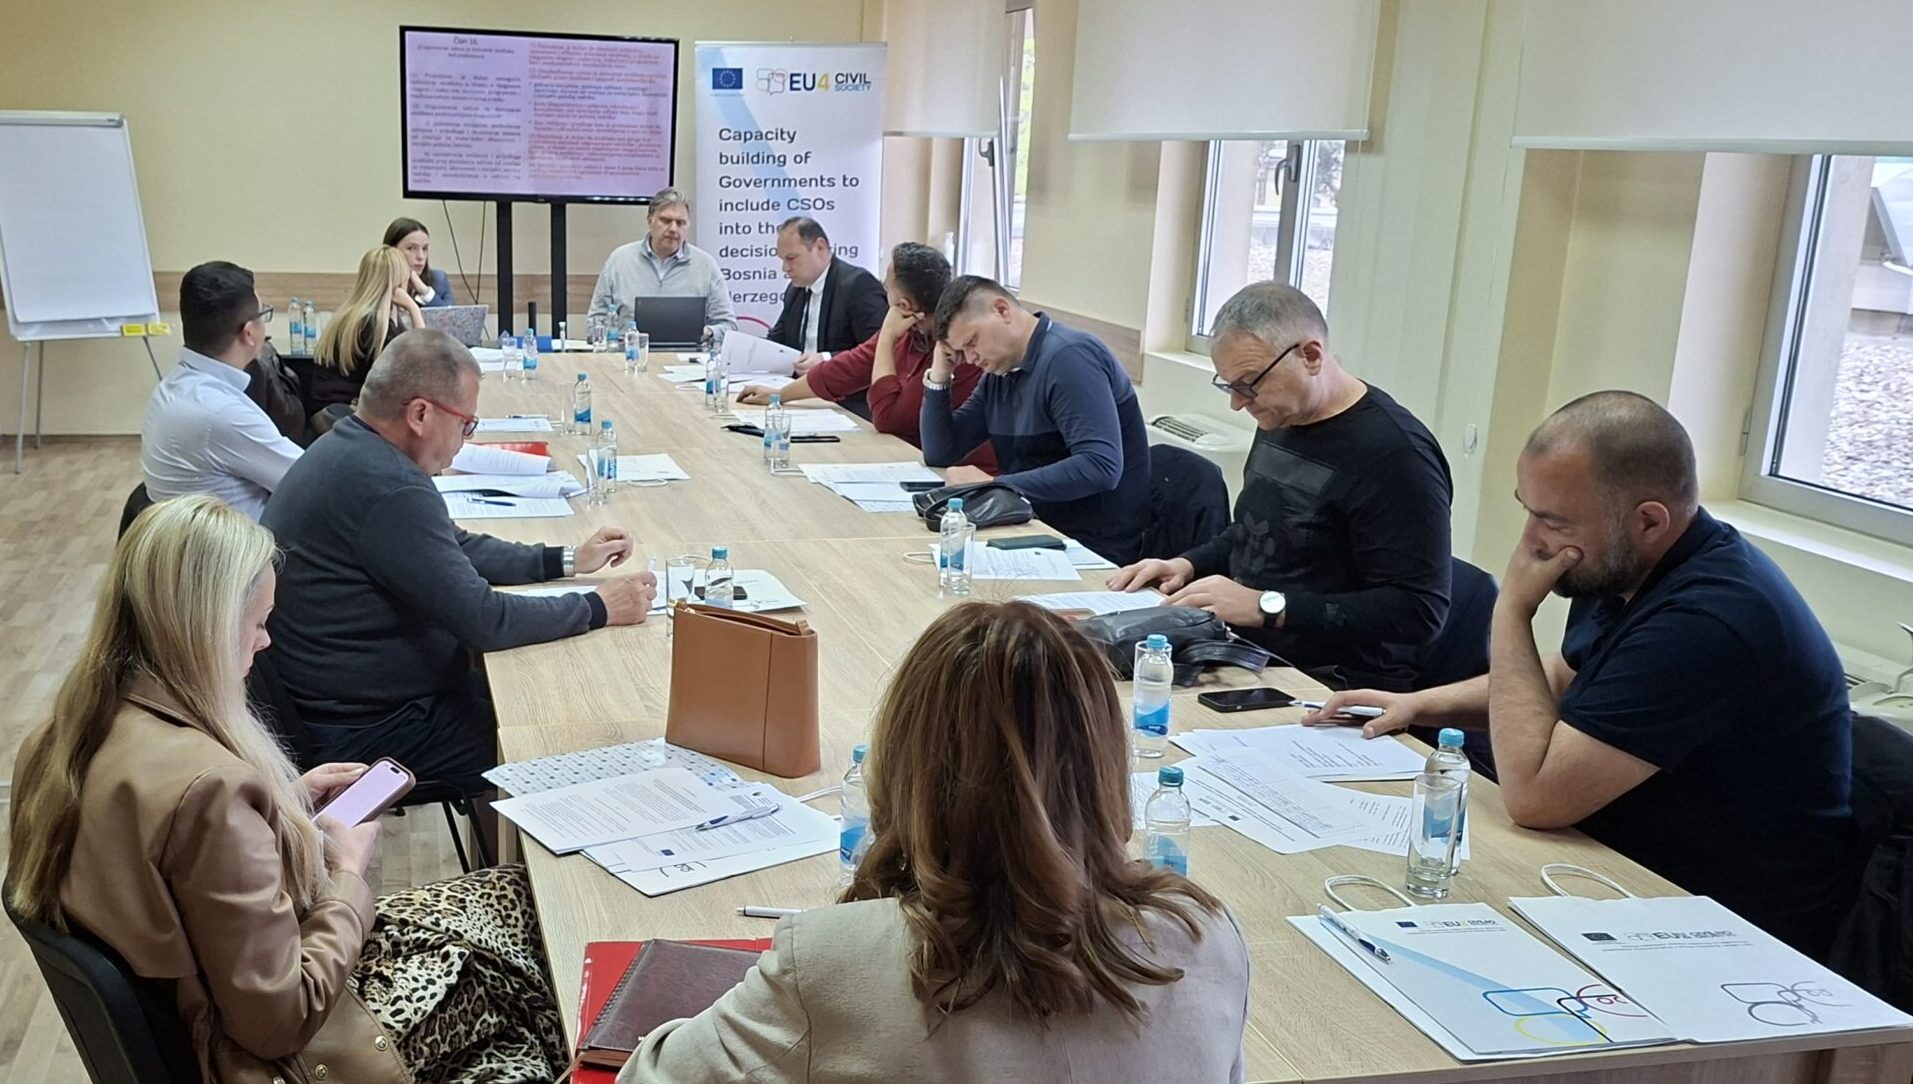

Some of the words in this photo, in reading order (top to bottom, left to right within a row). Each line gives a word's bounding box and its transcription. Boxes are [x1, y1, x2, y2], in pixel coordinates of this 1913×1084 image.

[789, 72, 830, 91] EU4
[835, 72, 872, 84] CIVIL
[834, 84, 872, 92] SOCIETY
[719, 128, 797, 144] Capacity
[719, 152, 787, 168] building
[793, 151, 813, 165] of
[719, 175, 837, 189] Governments
[842, 174, 860, 188] to
[719, 199, 781, 212] include
[787, 197, 836, 211] CSOs
[719, 222, 752, 236] into
[719, 245, 779, 258] decisio
[729, 291, 786, 305] erzeg
